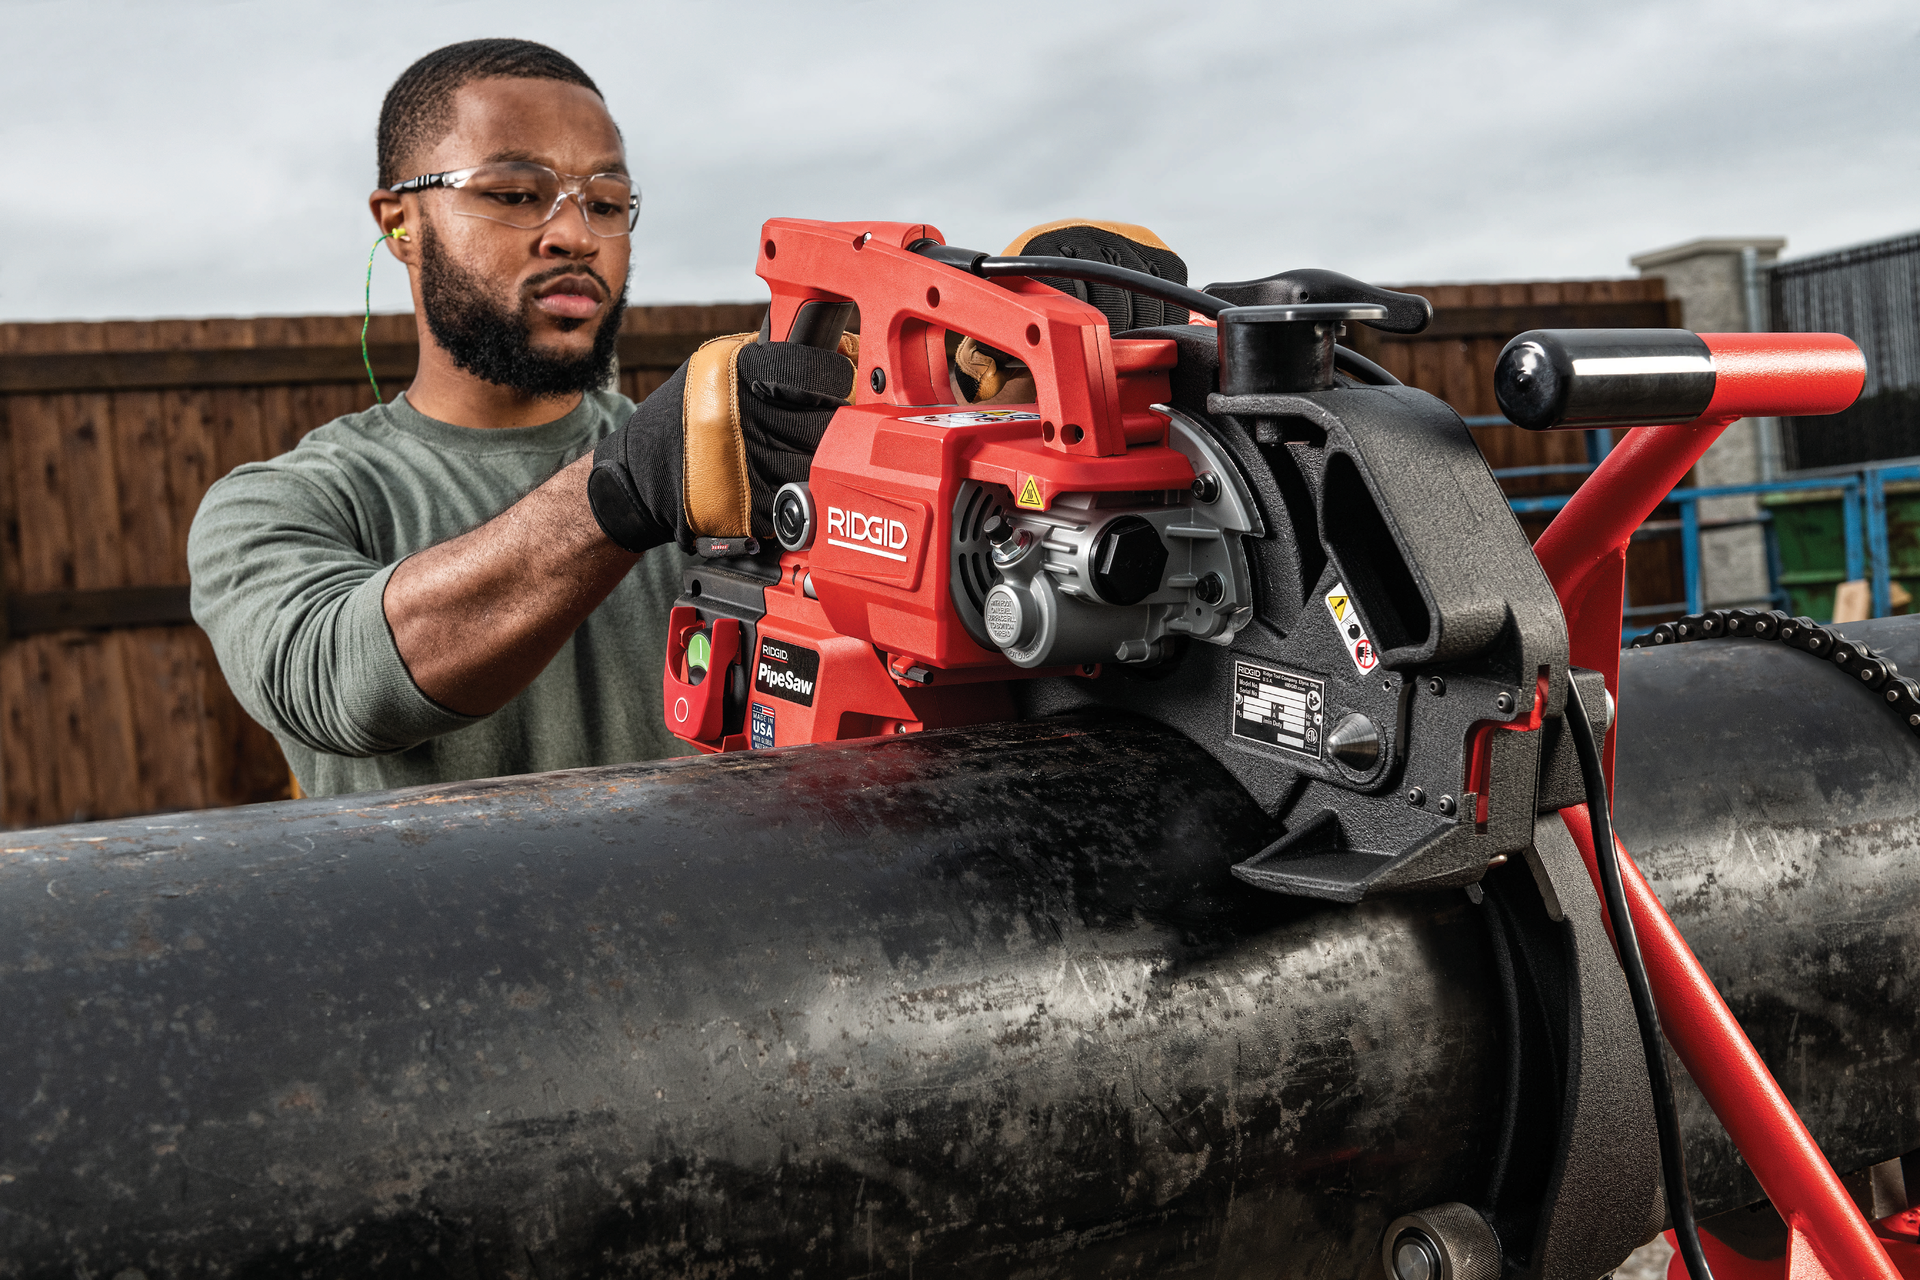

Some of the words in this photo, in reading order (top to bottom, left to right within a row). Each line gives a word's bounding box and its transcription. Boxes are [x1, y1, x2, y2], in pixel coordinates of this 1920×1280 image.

[828, 506, 909, 550] RIDGID
[999, 607, 1012, 615] LEVEL
[1007, 615, 1016, 623] FILL
[1238, 666, 1260, 677] RIDGID
[758, 662, 813, 695] PipeSaw
[1239, 679, 1251, 687] Model
[1273, 672, 1281, 680] Tool
[1281, 675, 1297, 684] Company
[1239, 686, 1251, 694] Serial
[1284, 683, 1305, 691] RIDGID.com
[753, 712, 767, 722] MADE
[767, 716, 774, 725] IN
[753, 720, 773, 738] USA
[1273, 720, 1282, 729] Duty
